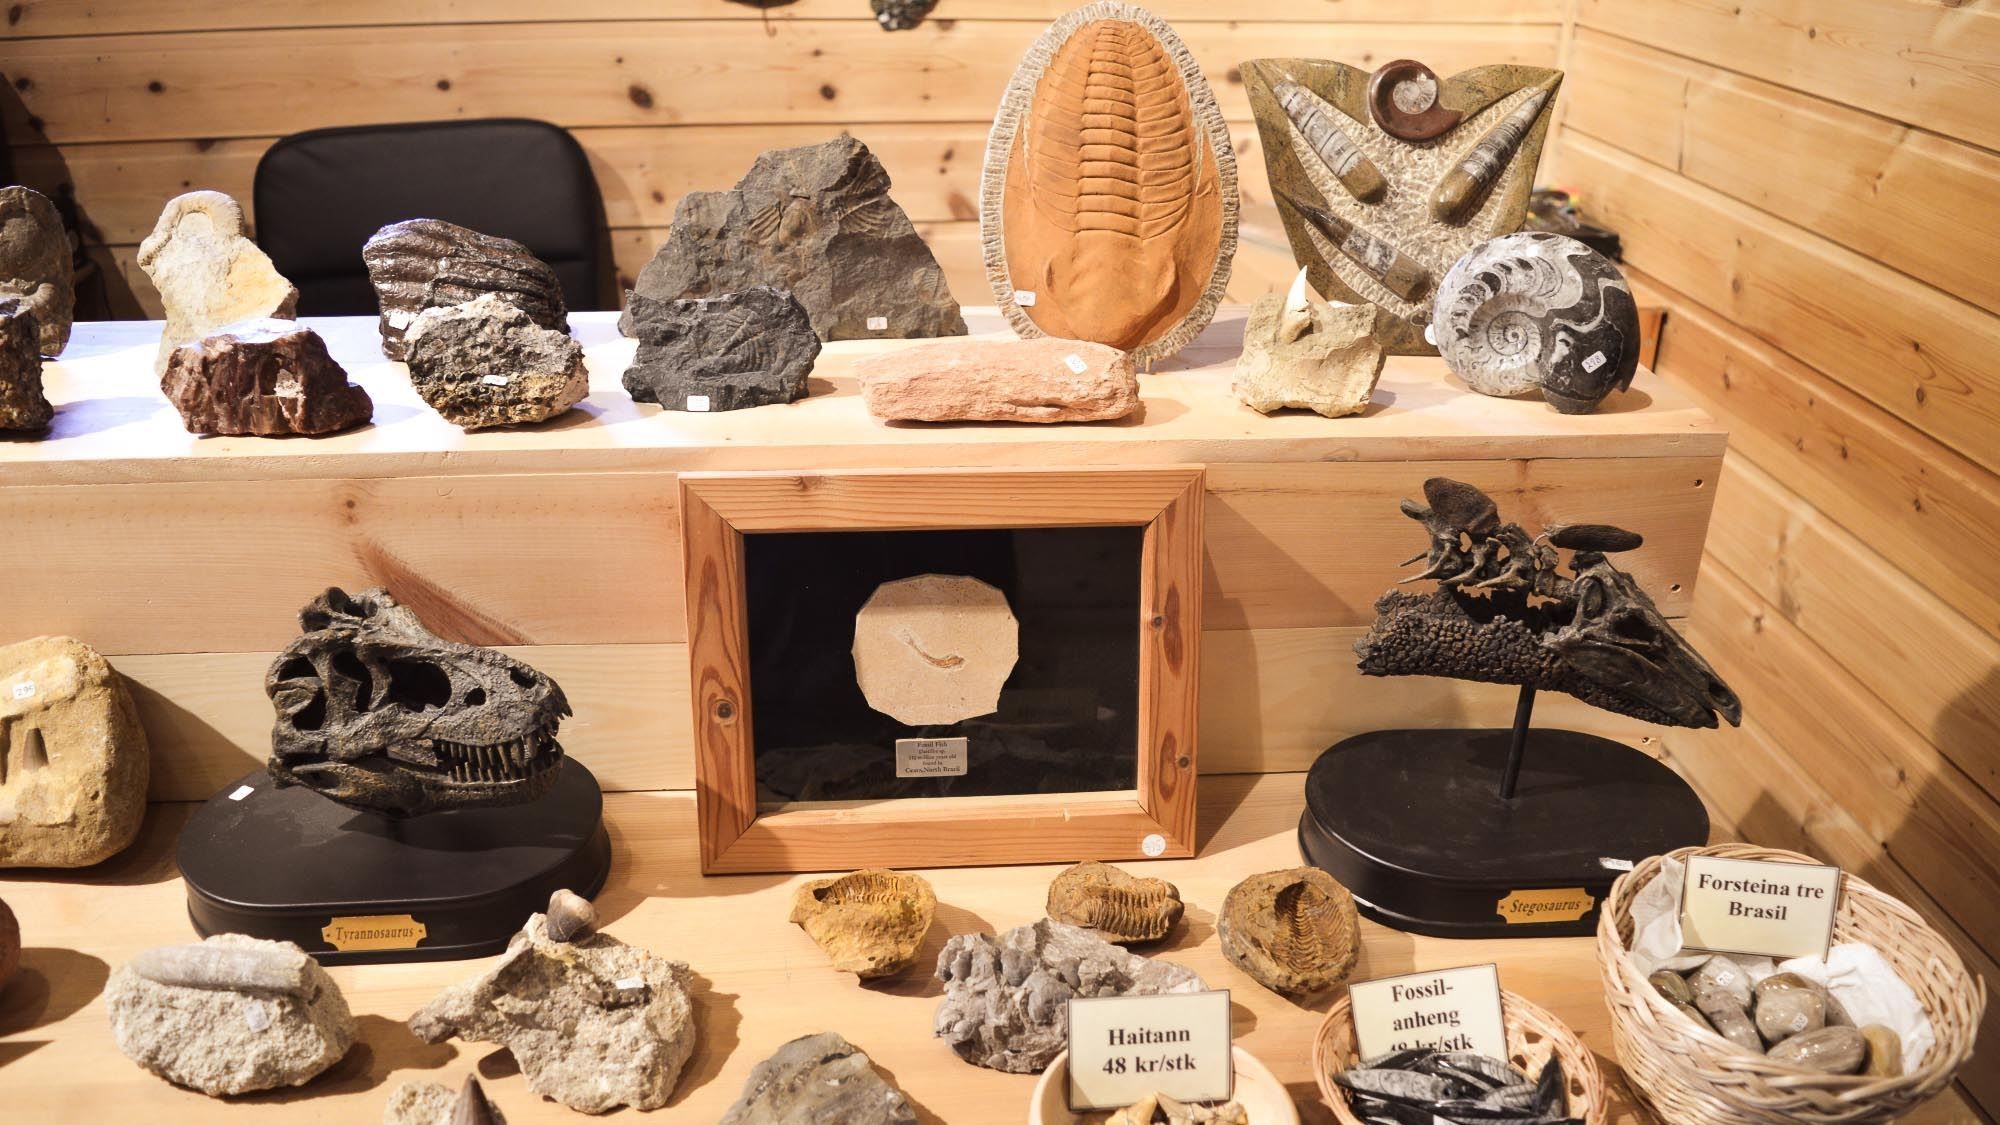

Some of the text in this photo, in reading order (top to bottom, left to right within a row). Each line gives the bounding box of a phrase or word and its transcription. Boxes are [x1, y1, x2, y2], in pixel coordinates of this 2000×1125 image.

[1584, 354, 1602, 371] 298
[1697, 873, 1825, 899] Forsteina tre
[1510, 899, 1582, 916] Stegosaurus
[1728, 901, 1787, 920] Brasil
[335, 926, 415, 944] Tyrannosaurus
[1391, 979, 1454, 1002] Fossil-
[1393, 1010, 1461, 1031] anheng
[1107, 1027, 1191, 1046] Haitann
[1102, 1053, 1197, 1075] 48 kr/stk
